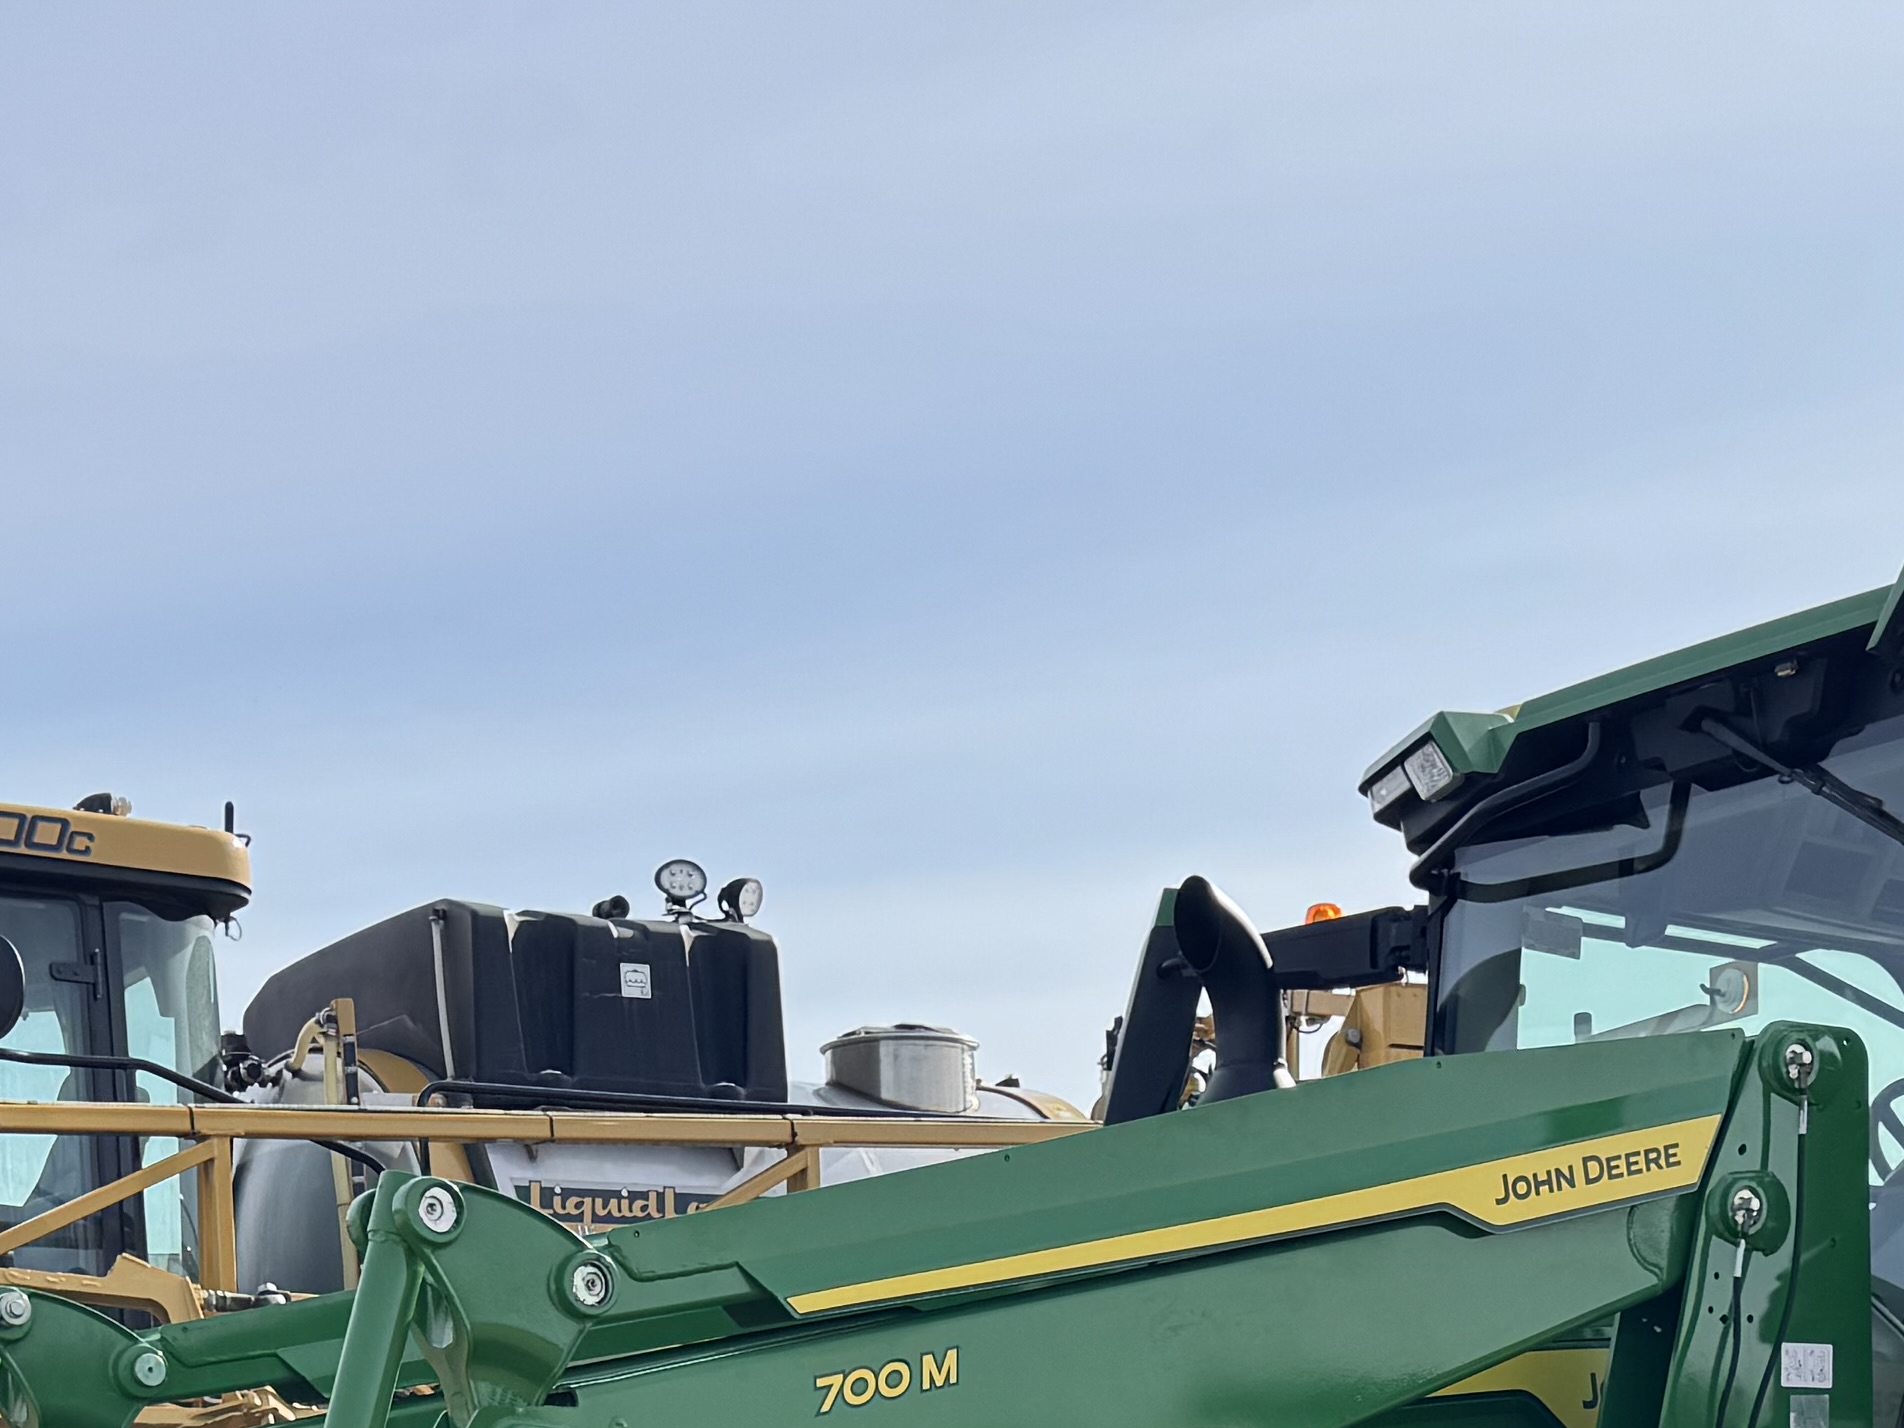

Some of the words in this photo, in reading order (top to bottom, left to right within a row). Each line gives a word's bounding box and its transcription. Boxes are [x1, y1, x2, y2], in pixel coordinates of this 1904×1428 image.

[1495, 1164, 1576, 1206] JOHN
[1582, 1142, 1682, 1186] DEERE
[815, 1359, 911, 1414] 700
[921, 1346, 958, 1391] M
